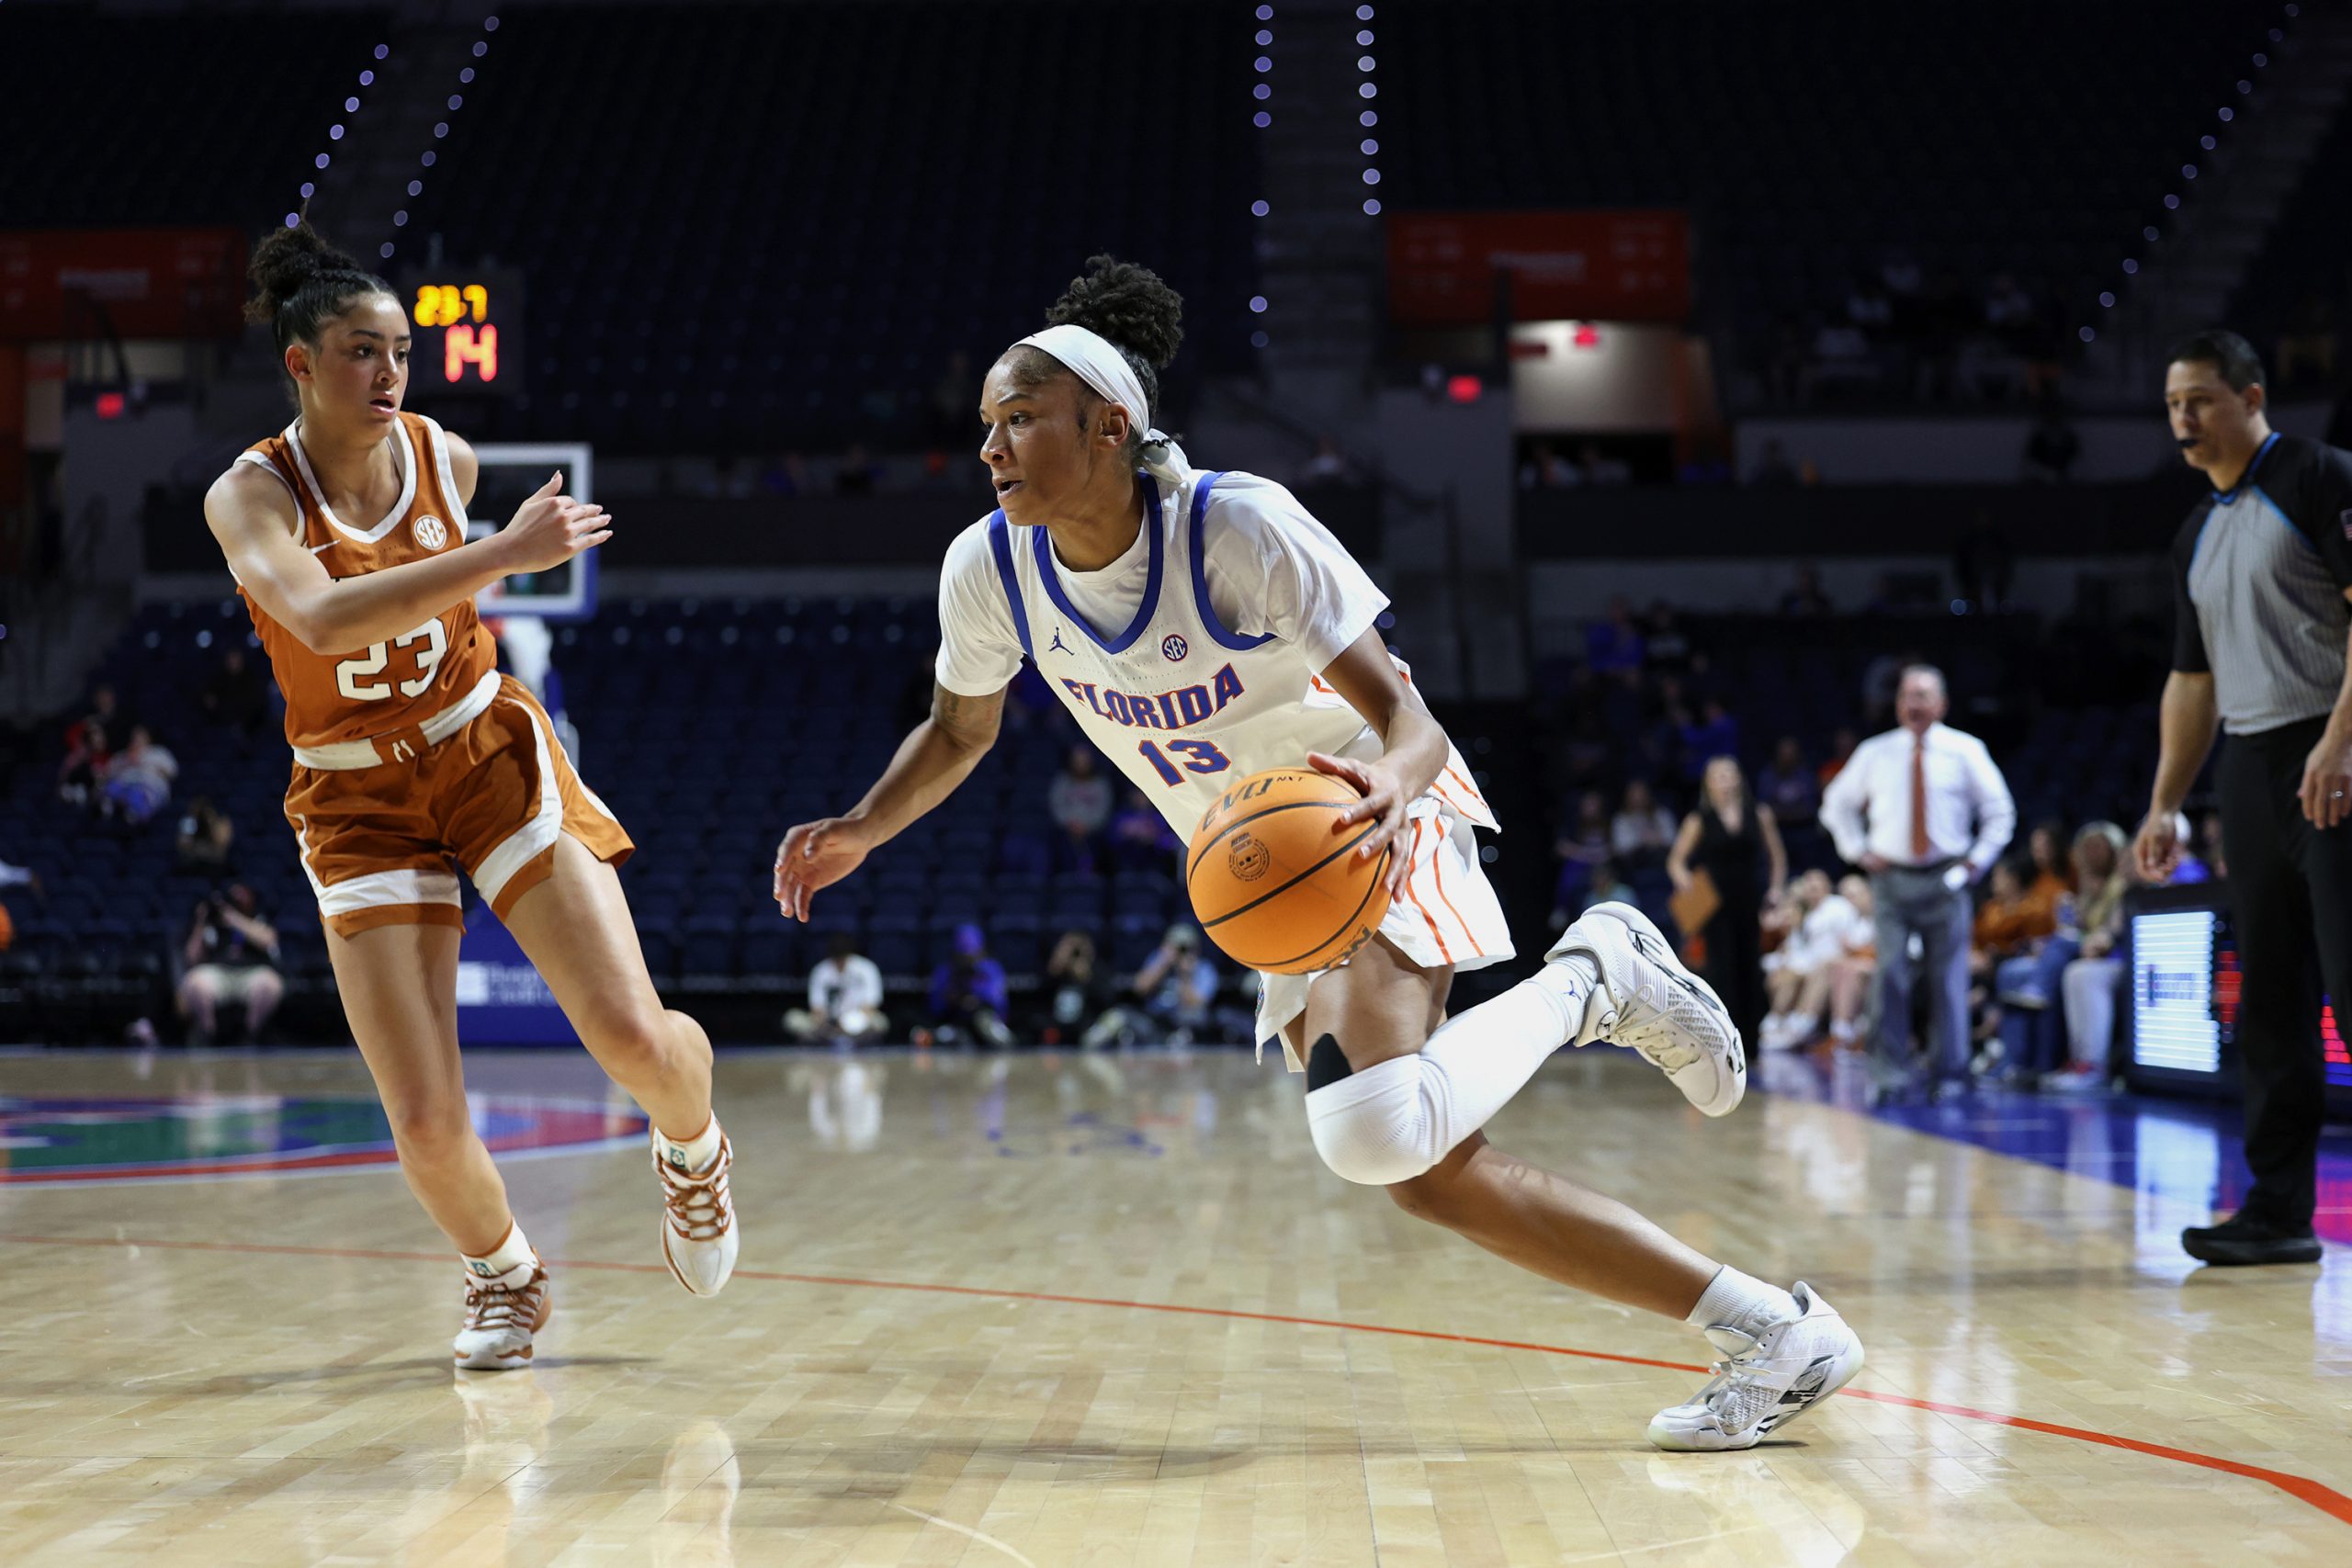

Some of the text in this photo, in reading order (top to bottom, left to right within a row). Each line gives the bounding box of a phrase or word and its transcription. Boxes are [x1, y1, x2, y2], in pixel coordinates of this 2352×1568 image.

[445, 323, 497, 383] 14
[414, 515, 447, 549] SEC
[335, 616, 448, 701] 23
[1163, 636, 1187, 660] SEC
[1058, 662, 1245, 730] FLORIDA
[1137, 739, 1232, 787] 13
